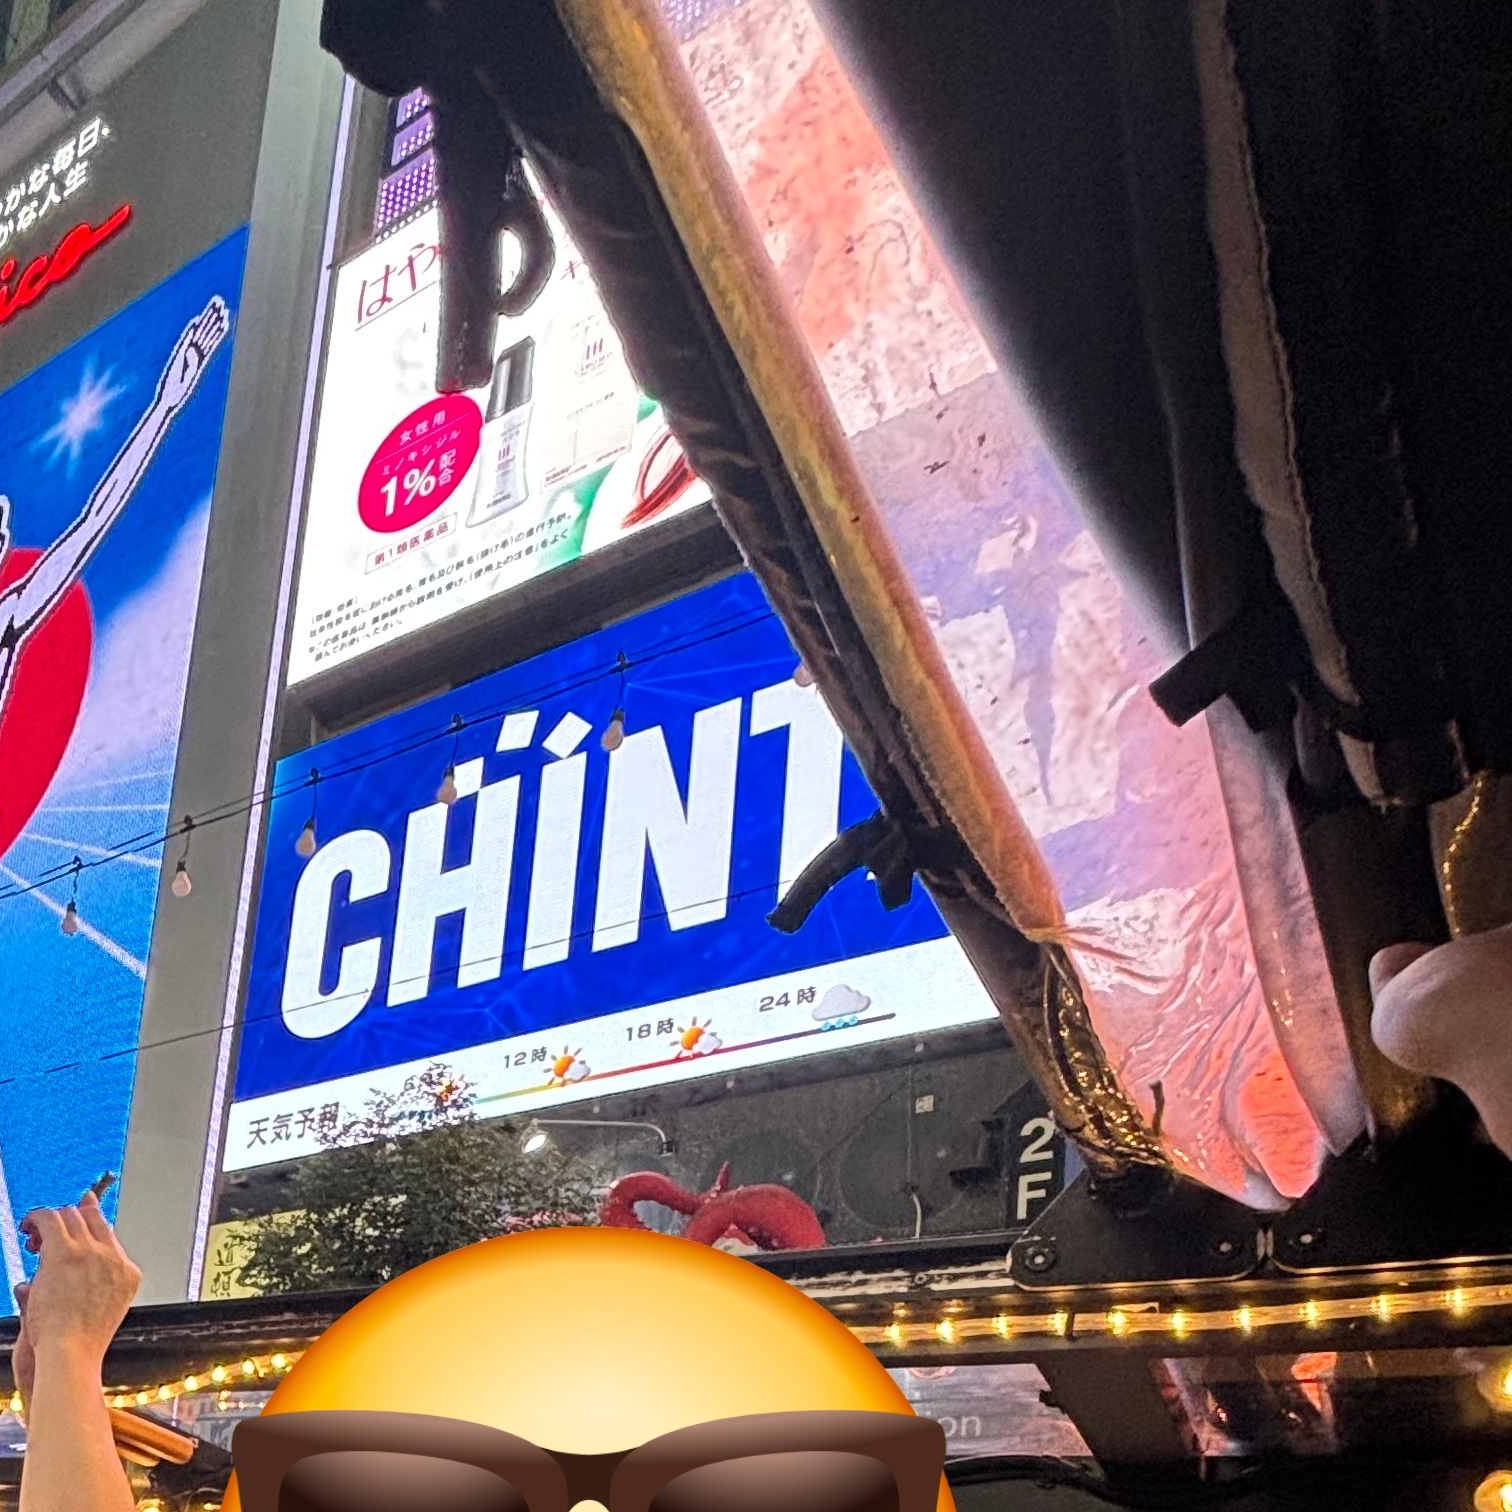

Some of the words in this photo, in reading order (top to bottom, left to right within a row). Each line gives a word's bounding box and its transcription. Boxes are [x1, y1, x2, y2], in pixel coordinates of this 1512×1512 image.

[399, 409, 446, 447] 女性用
[382, 429, 461, 476] ミノキシジル
[438, 448, 457, 487] 配合
[380, 458, 436, 517] 1%
[759, 986, 816, 1012] 24時
[626, 1018, 675, 1042] 18時
[503, 1046, 548, 1069] 12時
